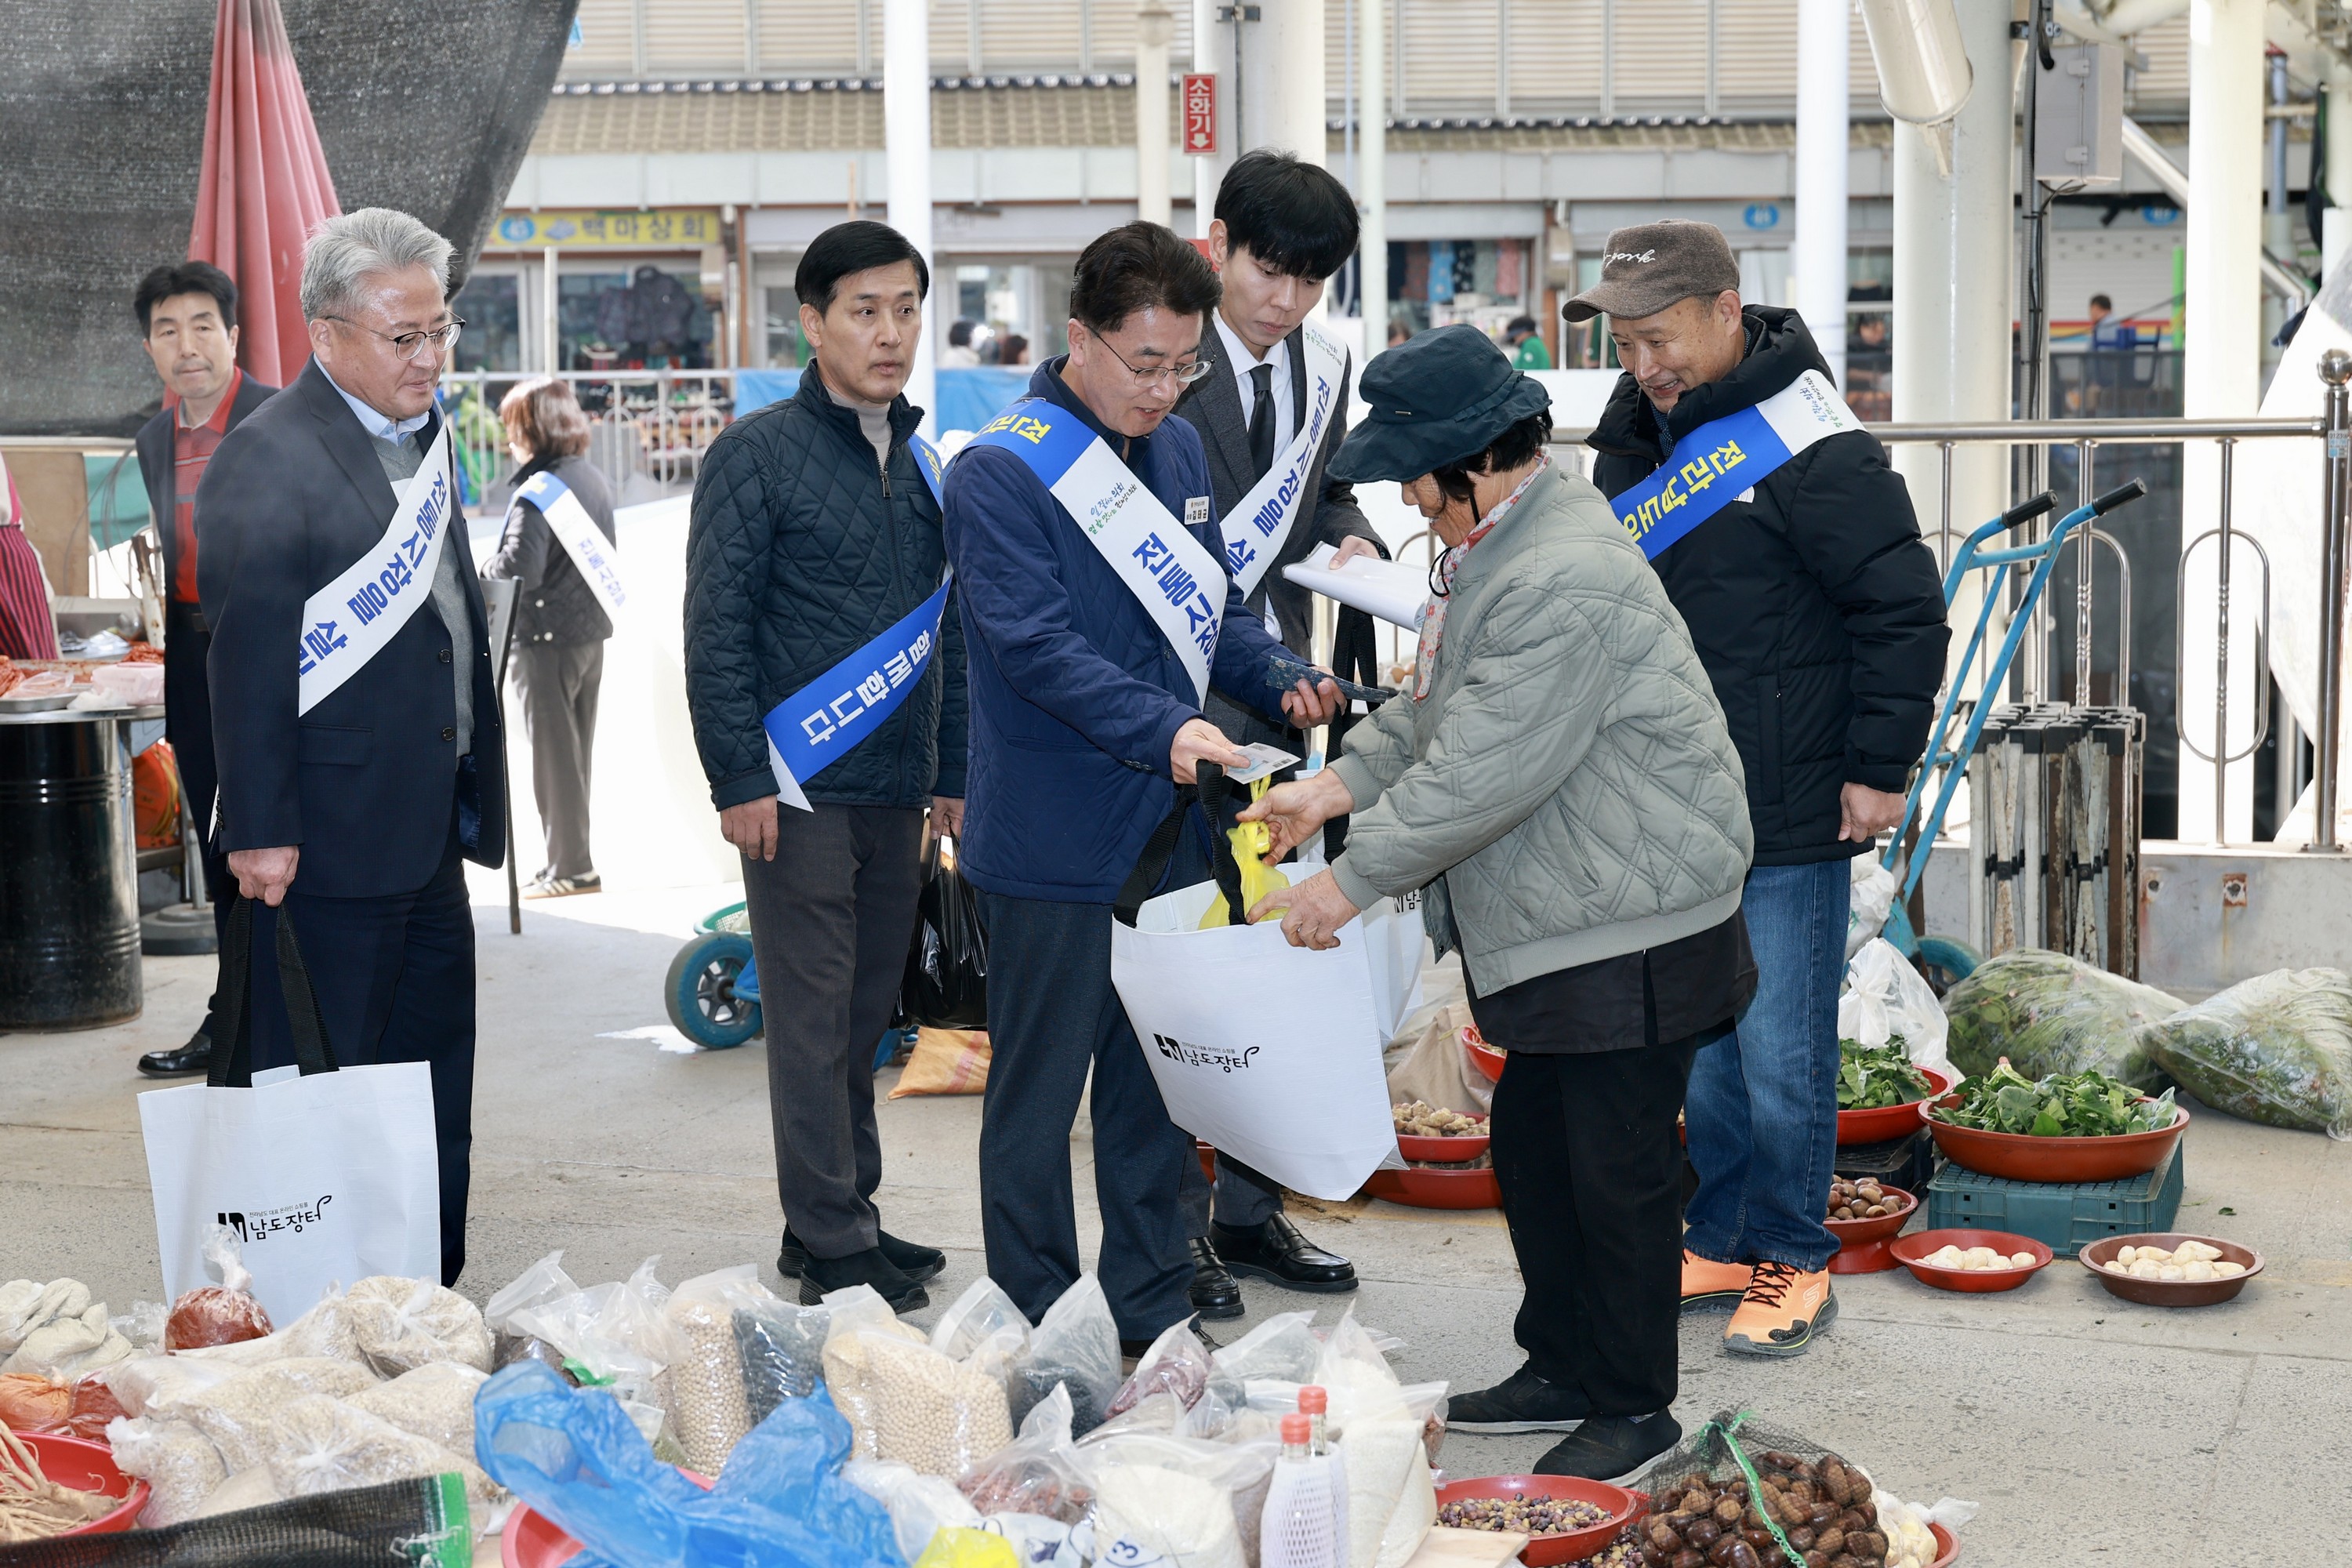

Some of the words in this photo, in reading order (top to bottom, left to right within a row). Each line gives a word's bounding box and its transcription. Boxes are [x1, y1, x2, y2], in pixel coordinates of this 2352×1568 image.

[1189, 78, 1211, 133] 소화기
[582, 213, 704, 240] 백마상회
[972, 413, 1053, 445] 전라
[1252, 375, 1331, 538] 전통시장을
[1111, 481, 1126, 498] 의회
[346, 470, 448, 627] 전통시장을
[1184, 1046, 1260, 1073] 남도장터
[250, 1195, 332, 1240] 남도장터
